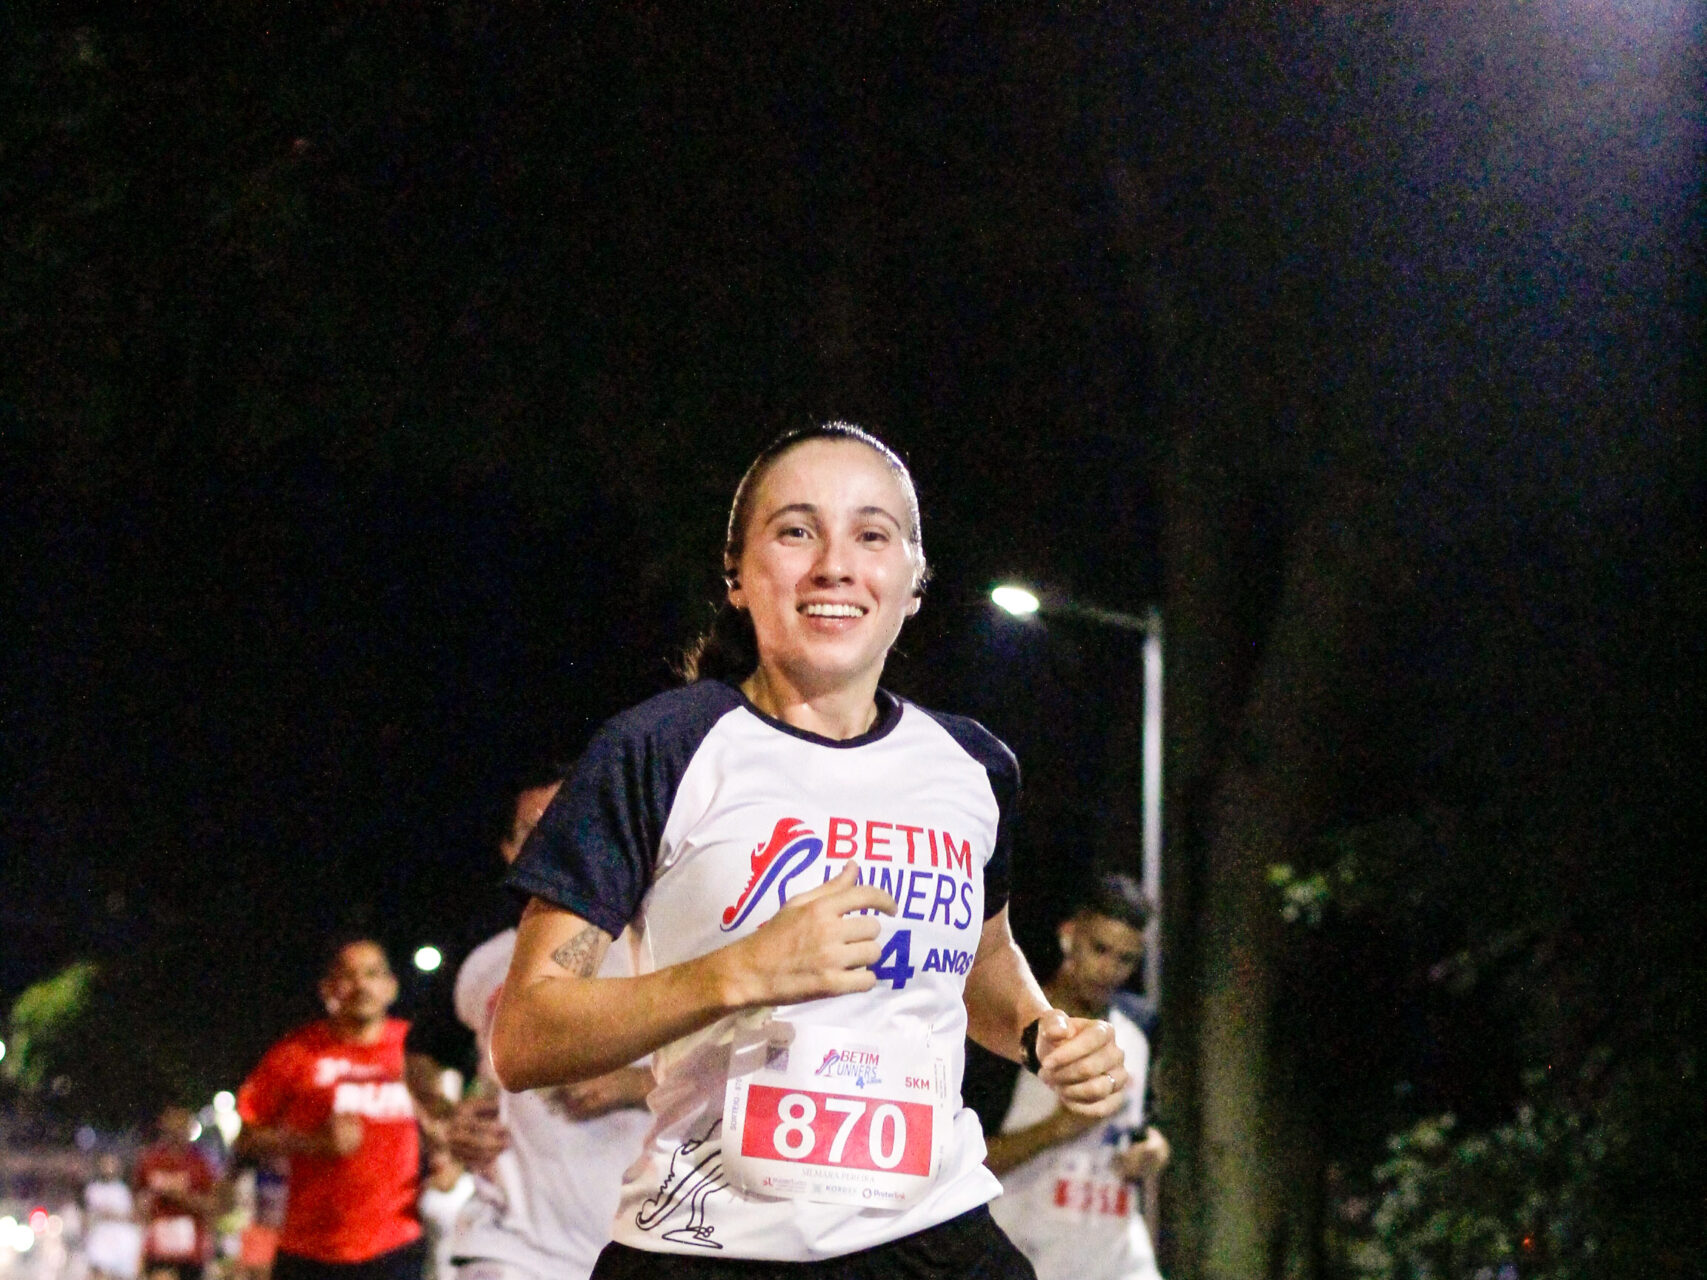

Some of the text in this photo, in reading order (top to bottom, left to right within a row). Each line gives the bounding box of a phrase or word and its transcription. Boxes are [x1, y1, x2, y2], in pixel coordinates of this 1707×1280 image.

[826, 816, 973, 880] BETIM
[866, 929, 974, 990] 4 ANOS
[840, 1050, 880, 1066] BETIM
[856, 1076, 865, 1089] 4
[905, 1076, 930, 1090] 5KM
[772, 1092, 907, 1170] 870
